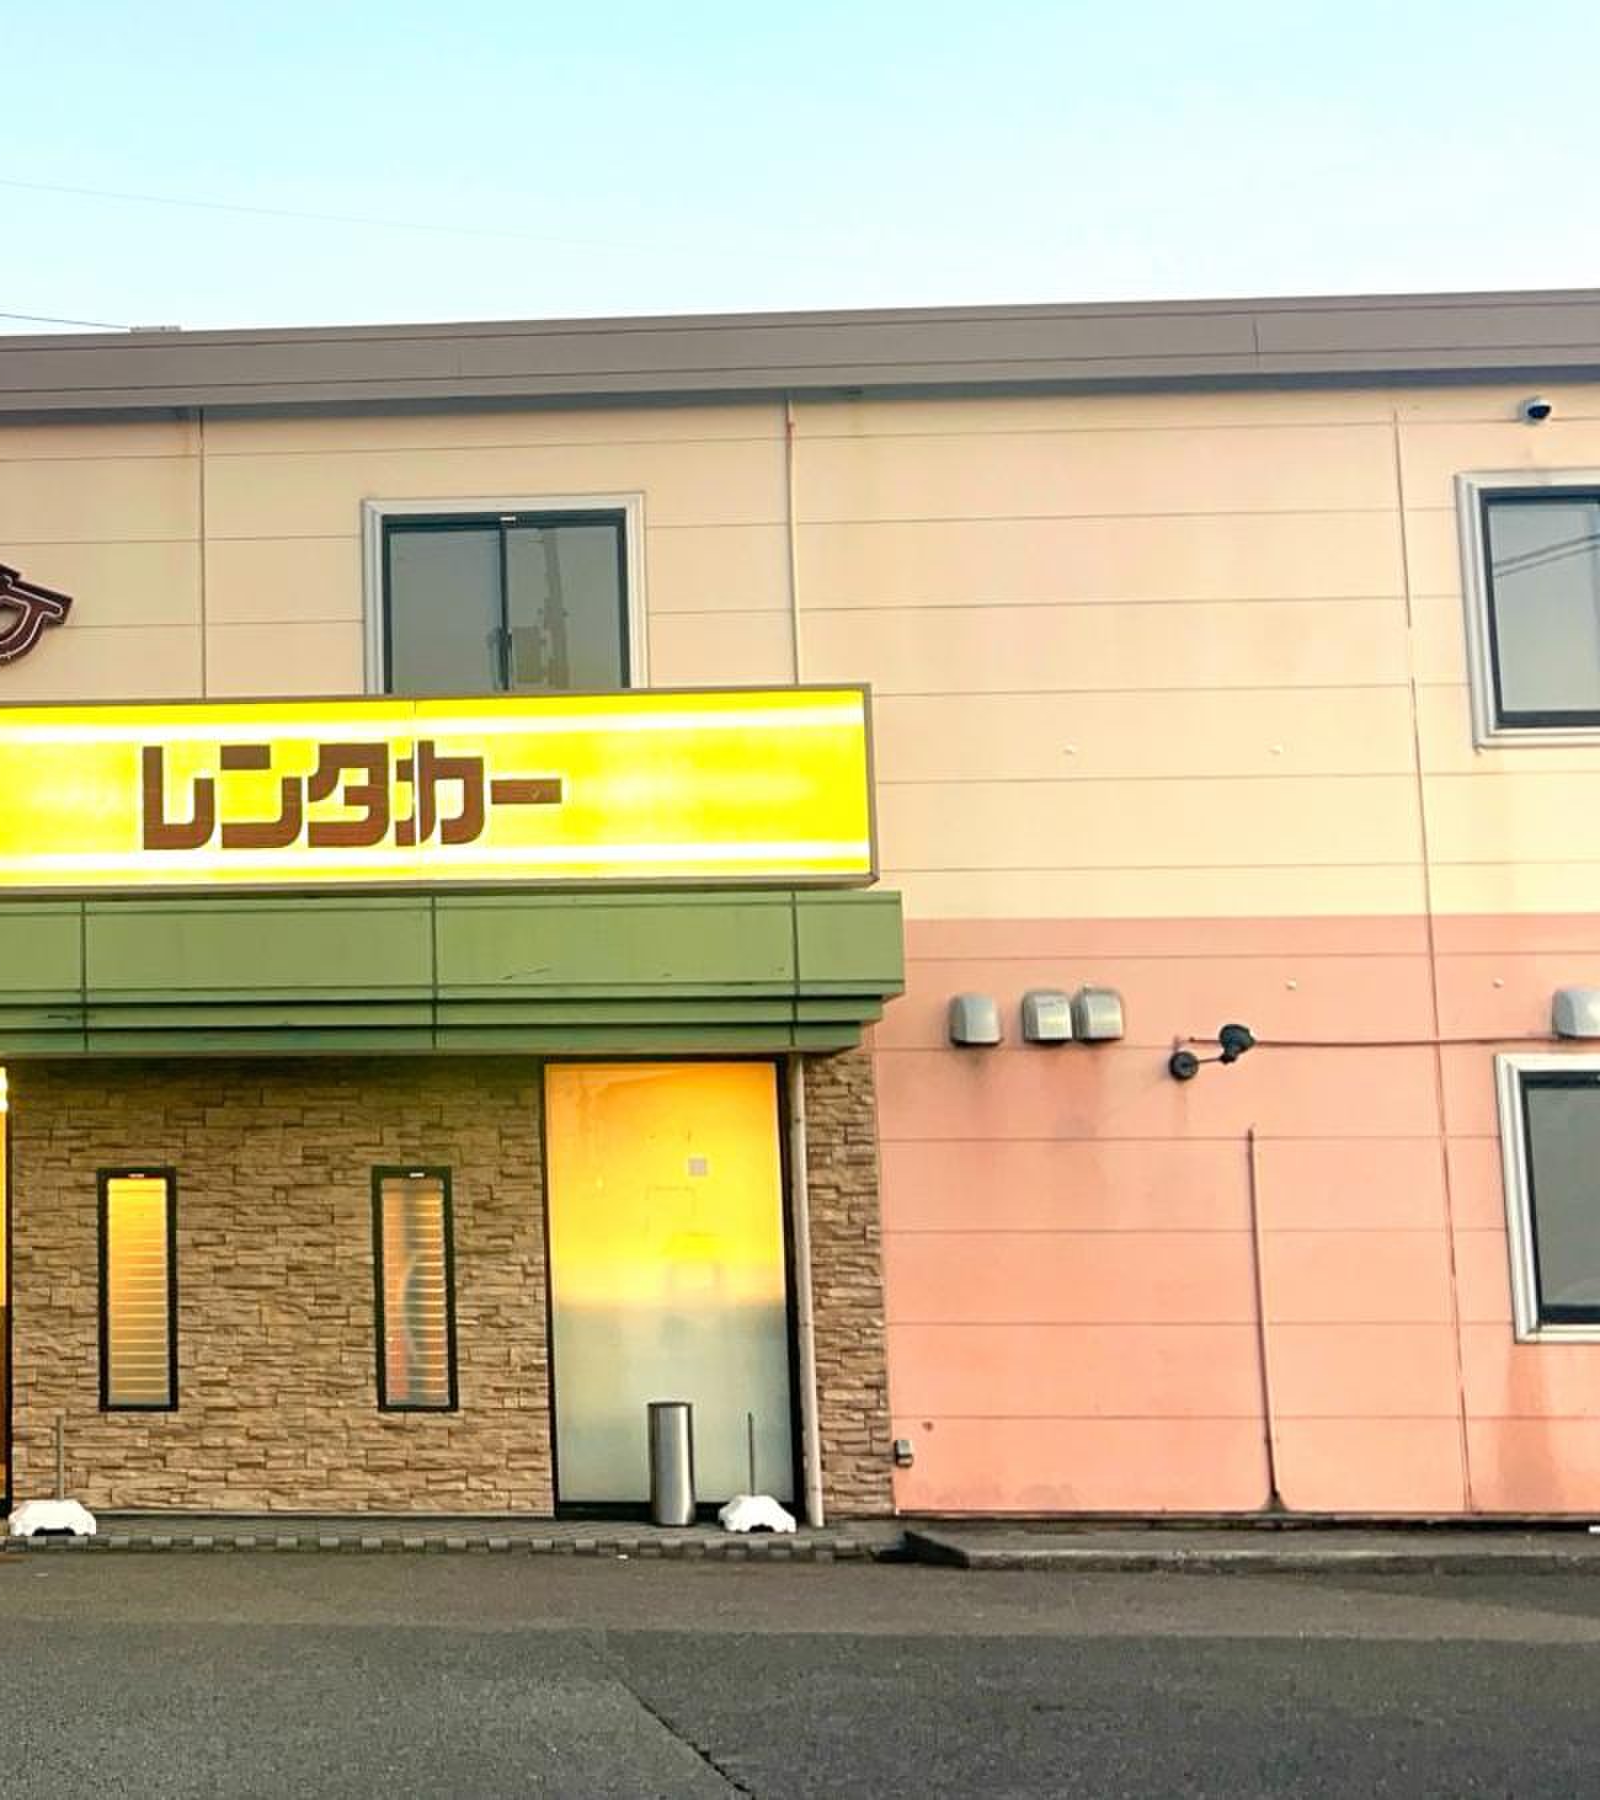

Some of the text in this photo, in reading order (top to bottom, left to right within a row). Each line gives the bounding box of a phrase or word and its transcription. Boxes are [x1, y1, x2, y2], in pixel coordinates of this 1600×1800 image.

[142, 740, 562, 850] レンタカー
